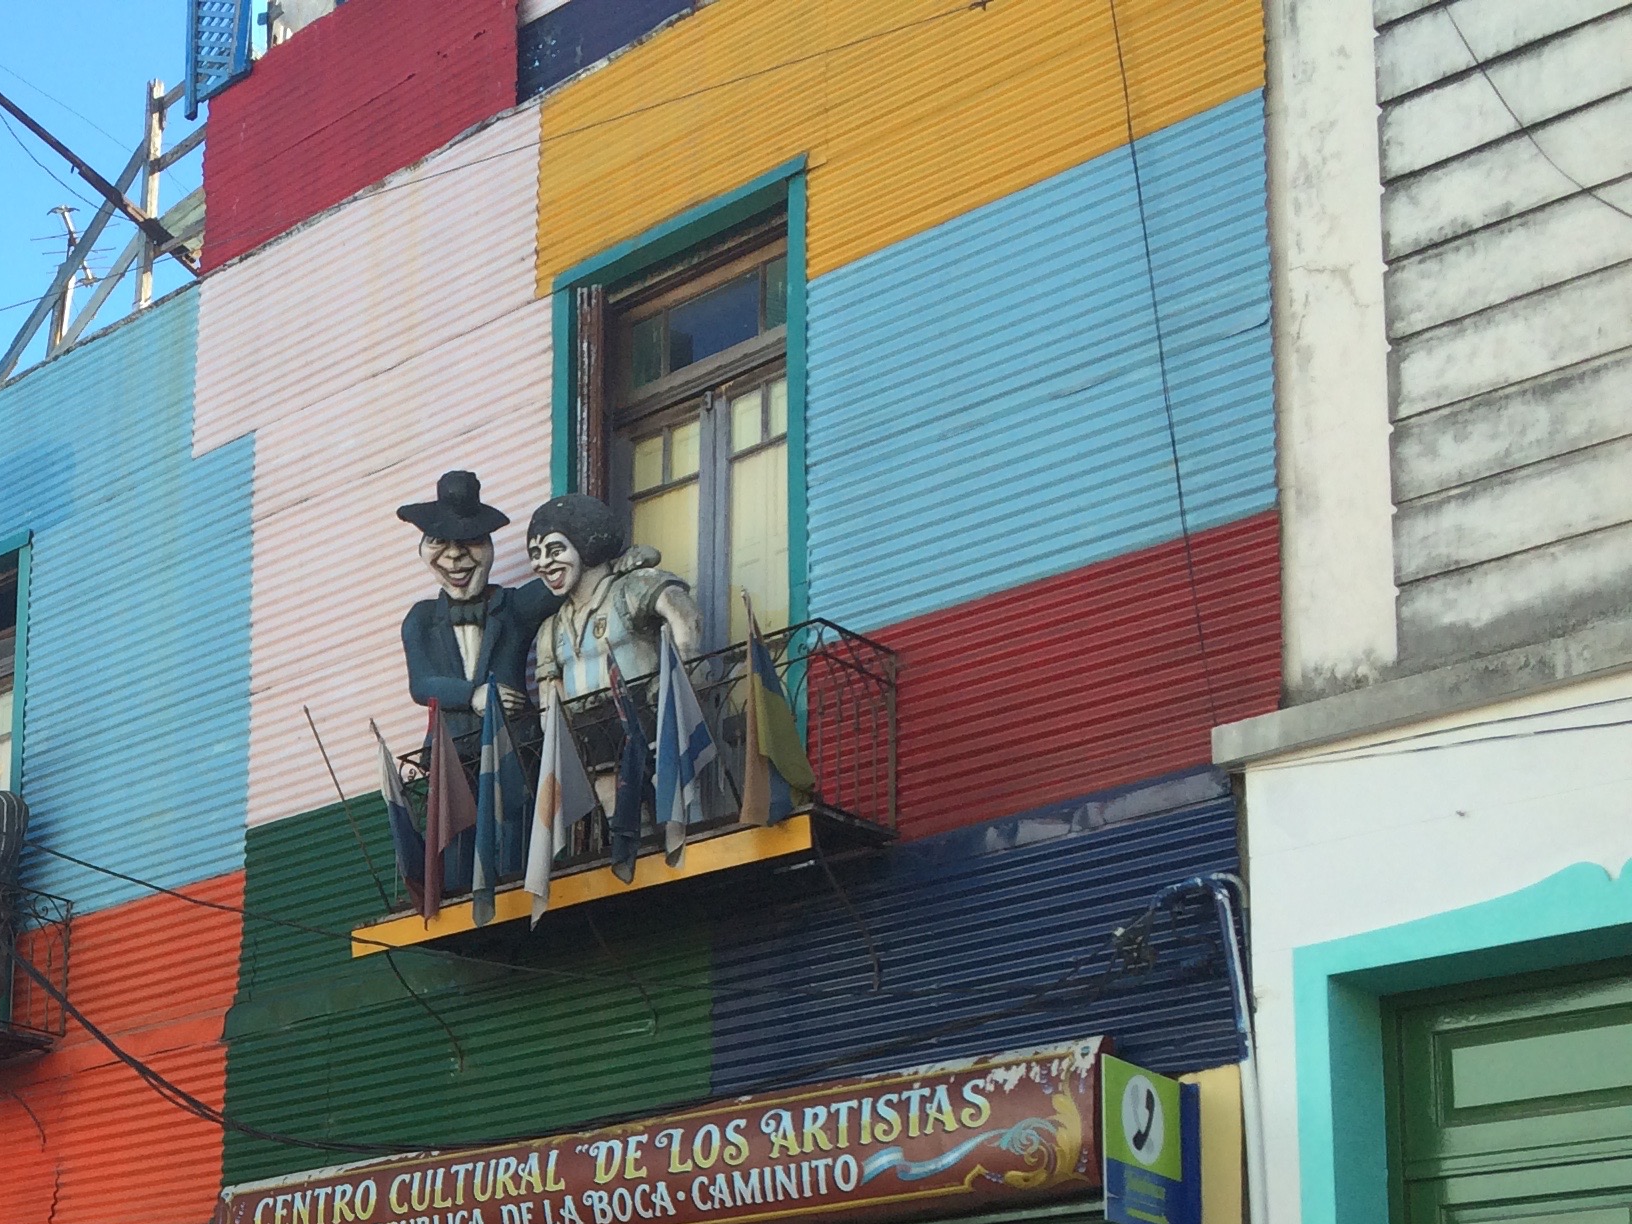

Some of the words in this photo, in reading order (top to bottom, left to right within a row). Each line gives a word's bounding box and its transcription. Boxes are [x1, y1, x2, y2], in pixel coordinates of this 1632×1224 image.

[388, 1149, 566, 1215] CULTURAL
[654, 1118, 751, 1174] LOS
[760, 1078, 991, 1159] ARTISTAS
[690, 1153, 859, 1212] CAMINITO
